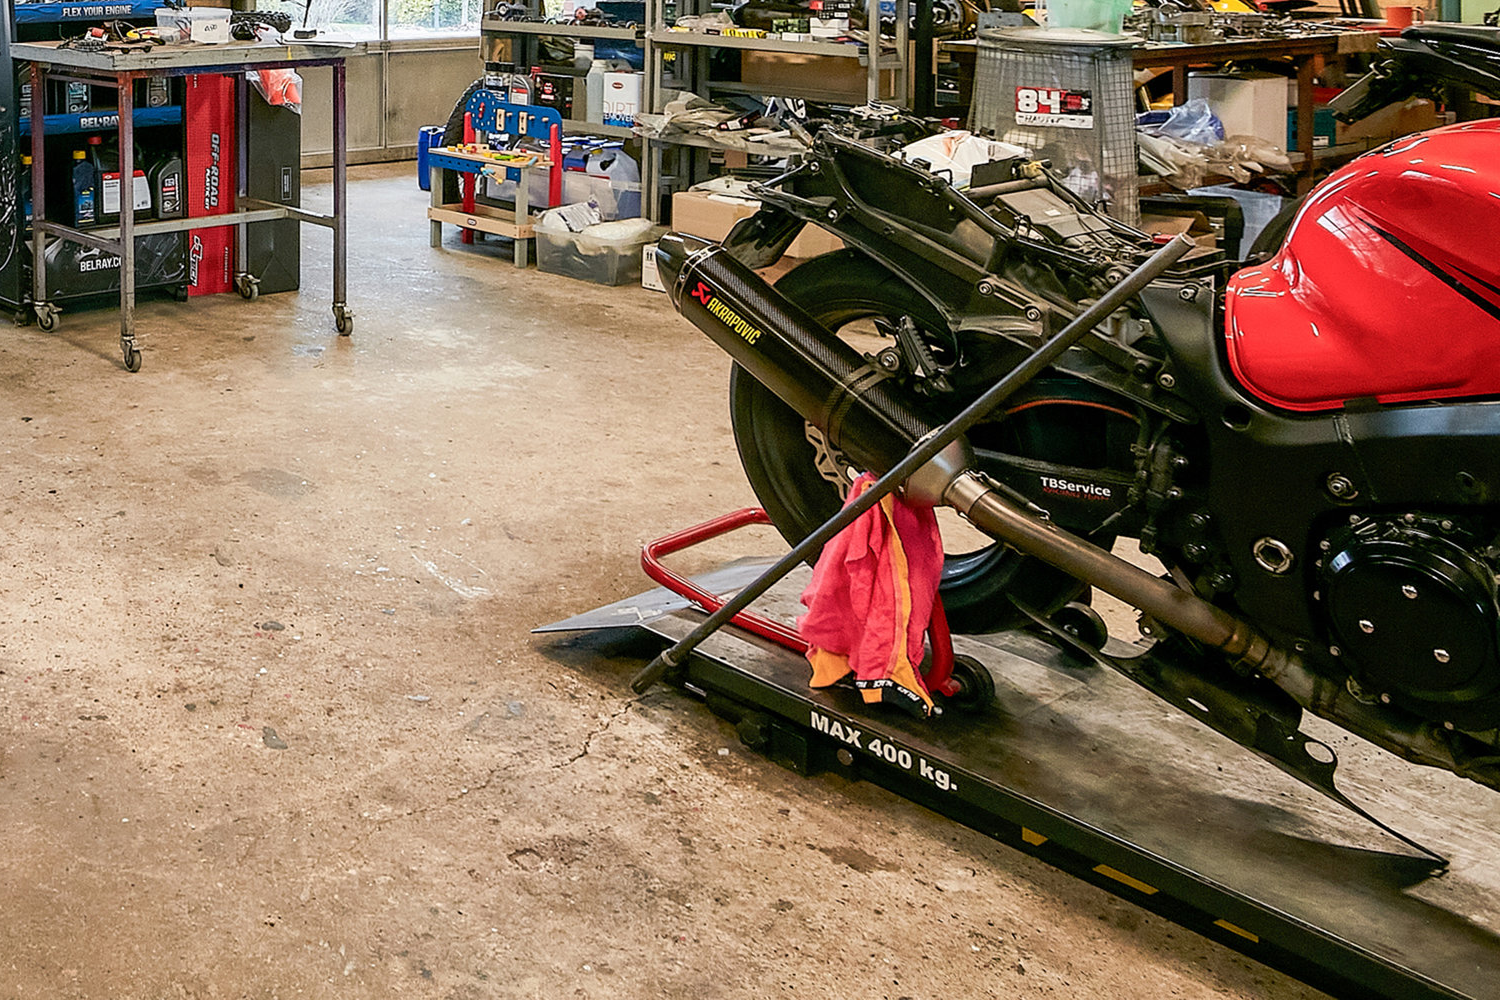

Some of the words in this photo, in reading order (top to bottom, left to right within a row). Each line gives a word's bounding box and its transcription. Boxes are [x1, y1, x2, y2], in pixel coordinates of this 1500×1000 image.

[62, 7, 82, 17] FLEX
[83, 6, 104, 16] YOUR
[105, 4, 132, 15] ENGINE
[1017, 89, 1060, 113] 84
[210, 132, 220, 207] OFF-ROAD
[1040, 476, 1111, 497] TBService
[810, 711, 863, 749] MAX
[868, 738, 912, 770] 400
[919, 758, 958, 791] kg.
